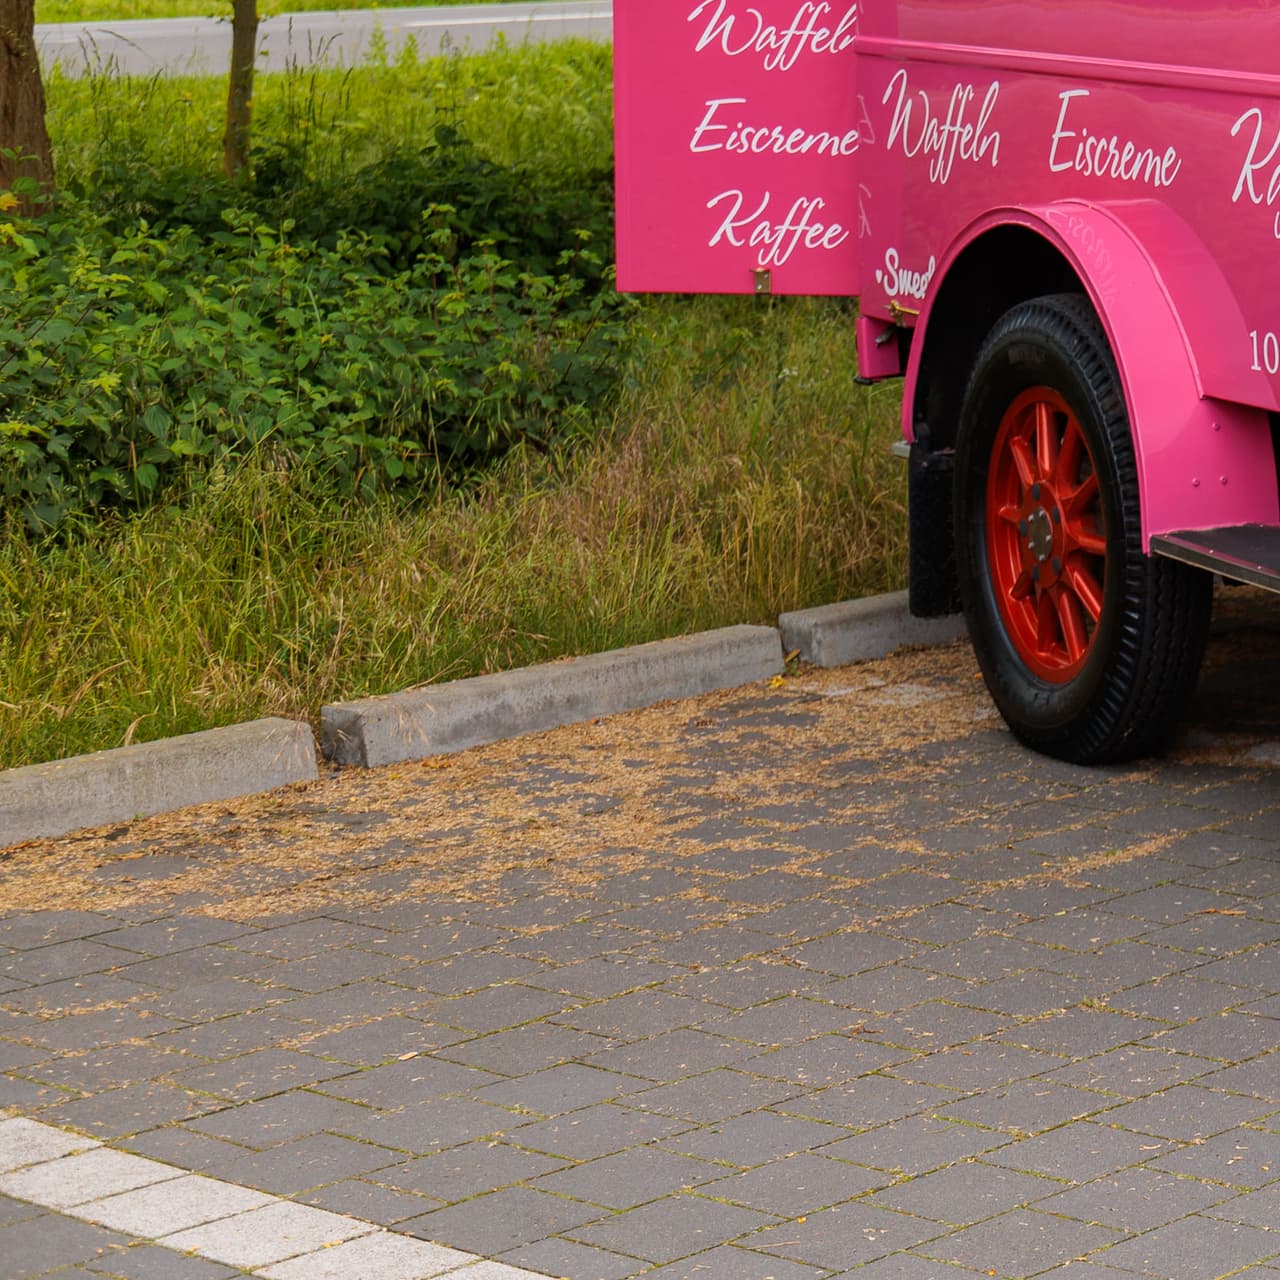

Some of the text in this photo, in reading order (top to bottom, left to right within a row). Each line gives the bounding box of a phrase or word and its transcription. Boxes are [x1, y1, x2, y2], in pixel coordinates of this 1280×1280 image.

[690, 98, 859, 157] Eiscreme
[882, 68, 1000, 184] Waffeln
[1049, 89, 1182, 188] Eiscreme
[707, 189, 850, 266] Kaffee
